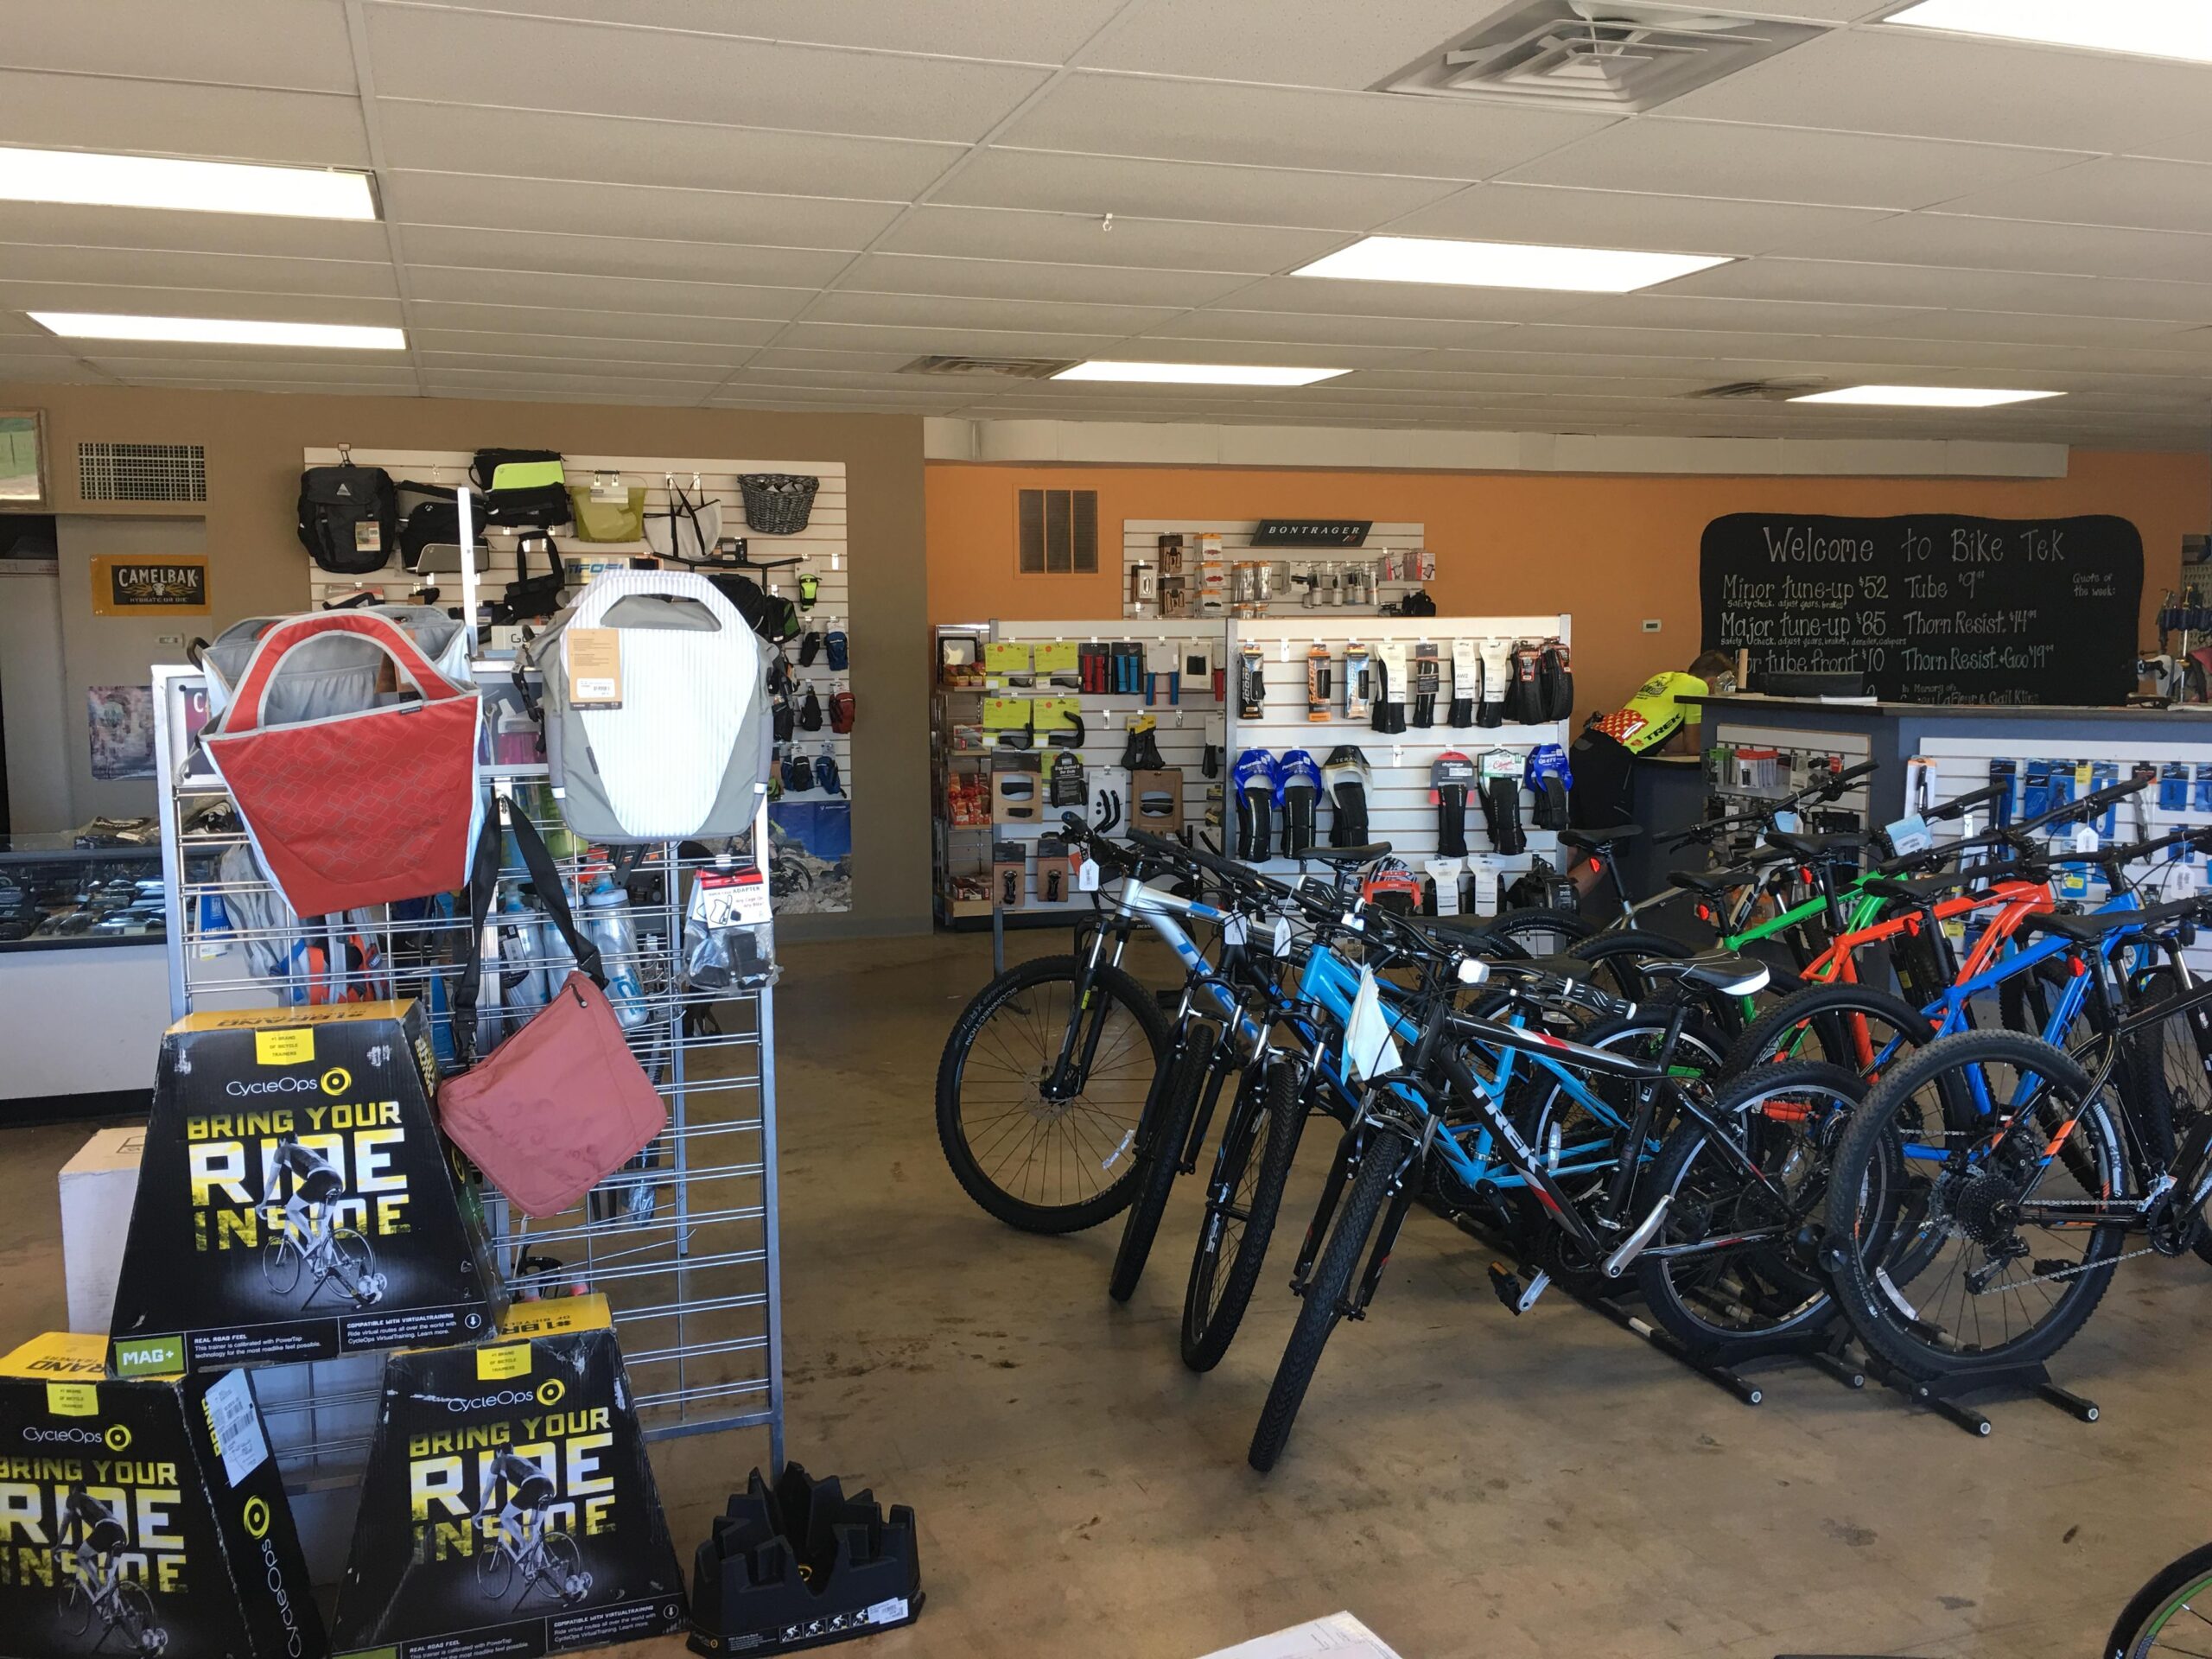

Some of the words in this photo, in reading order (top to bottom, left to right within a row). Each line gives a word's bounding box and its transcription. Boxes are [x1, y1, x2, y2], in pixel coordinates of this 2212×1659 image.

[1763, 527, 1873, 562] Welcome
[1901, 527, 1932, 562] to
[1951, 528, 2004, 562] Bike
[118, 569, 196, 587] CAMELBAK
[1722, 575, 1775, 599] Minor
[1783, 575, 1854, 605] tune-up
[1859, 575, 1889, 599] $52
[1903, 575, 1948, 599] Tube
[1721, 612, 1774, 645] Major
[1780, 611, 1851, 640] tune-up
[1856, 610, 1886, 636] $85
[1903, 610, 1951, 634] Thorn
[1765, 649, 1807, 672] tube
[1810, 649, 1858, 672] front
[1861, 648, 1885, 671] $10
[1901, 648, 1947, 671] Thorn
[1643, 713, 1681, 741] TREK
[226, 1077, 317, 1096] CycleOps
[187, 1109, 294, 1140] BRING
[304, 1101, 402, 1130] YOUR
[1472, 1085, 1542, 1174] TREK
[188, 1128, 408, 1206] RIDE
[346, 1319, 385, 1329] COMPATIBLE
[402, 1313, 454, 1323] VIRTUALTRAINING
[361, 1327, 378, 1336] virtual
[234, 1339, 262, 1348] calibrated
[347, 1337, 376, 1345] CycleOps
[417, 1329, 433, 1338] Learn
[122, 1348, 175, 1365] MAG+
[195, 1351, 226, 1360] technology
[448, 1389, 533, 1412] CycleOps
[22, 1427, 103, 1443] CycleOps
[409, 1421, 511, 1458] BRING
[521, 1407, 611, 1440] YOUR
[0, 1456, 83, 1481] BRING
[92, 1459, 178, 1485] YOUR
[410, 1432, 614, 1522] RIDE
[261, 1537, 302, 1658] CycleOps
